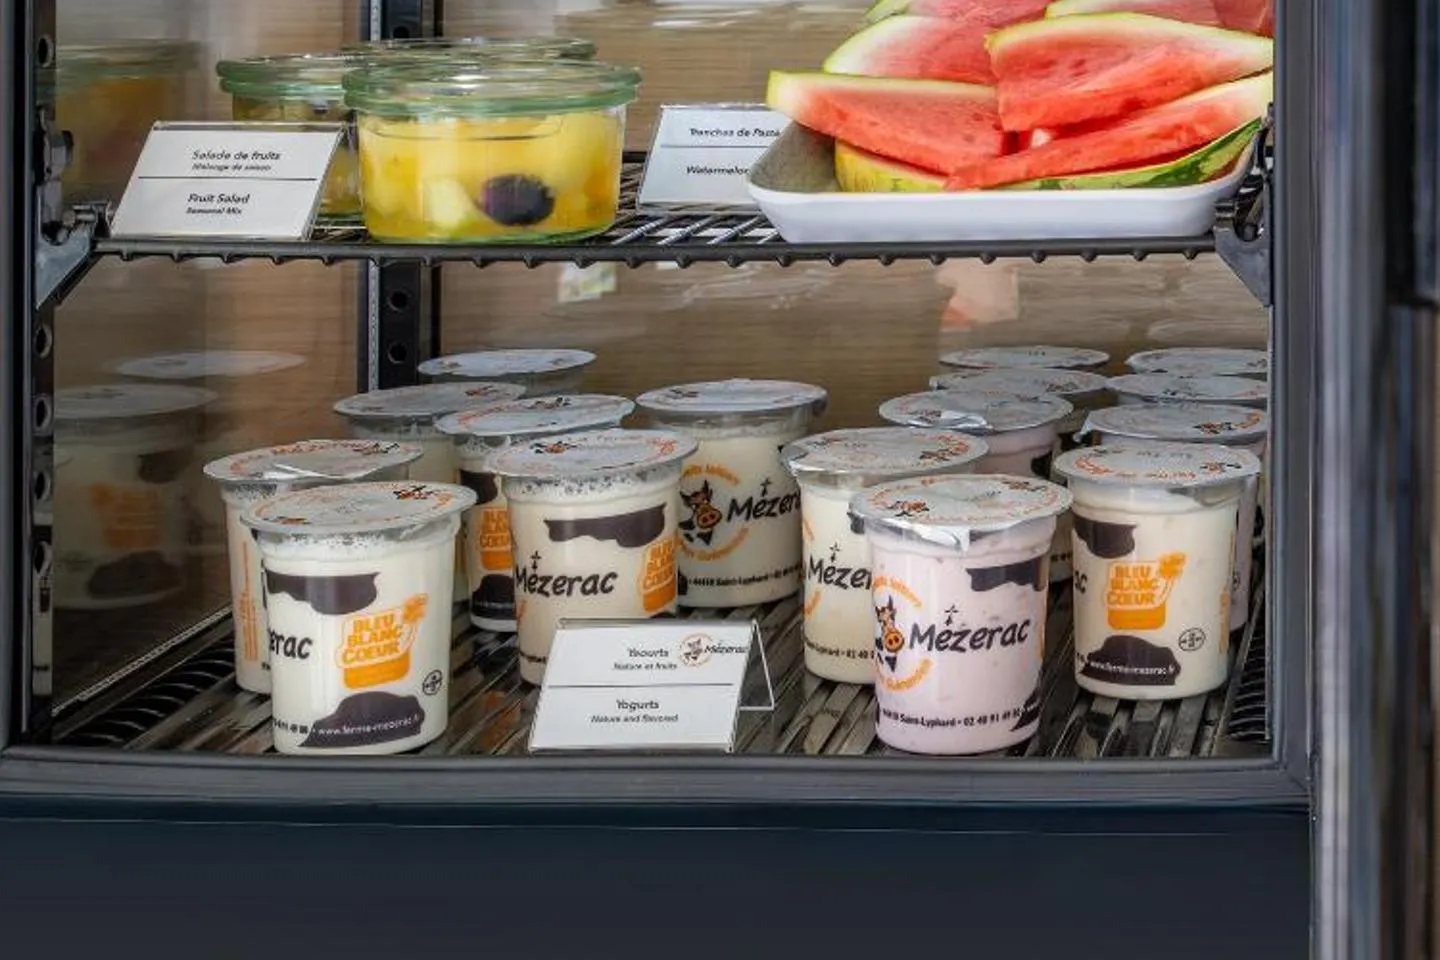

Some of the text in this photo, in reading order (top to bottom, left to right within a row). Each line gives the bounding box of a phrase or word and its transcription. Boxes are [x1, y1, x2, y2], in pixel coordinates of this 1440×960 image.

[690, 128, 734, 137] Tranches
[737, 128, 750, 137] de
[192, 150, 280, 160] Salade de fruits
[187, 193, 251, 203] Fruit Salad
[1114, 565, 1151, 578] BLEU
[352, 613, 394, 633] BLEU
[628, 648, 669, 657] Yaourts
[616, 700, 659, 711] Yogurts
